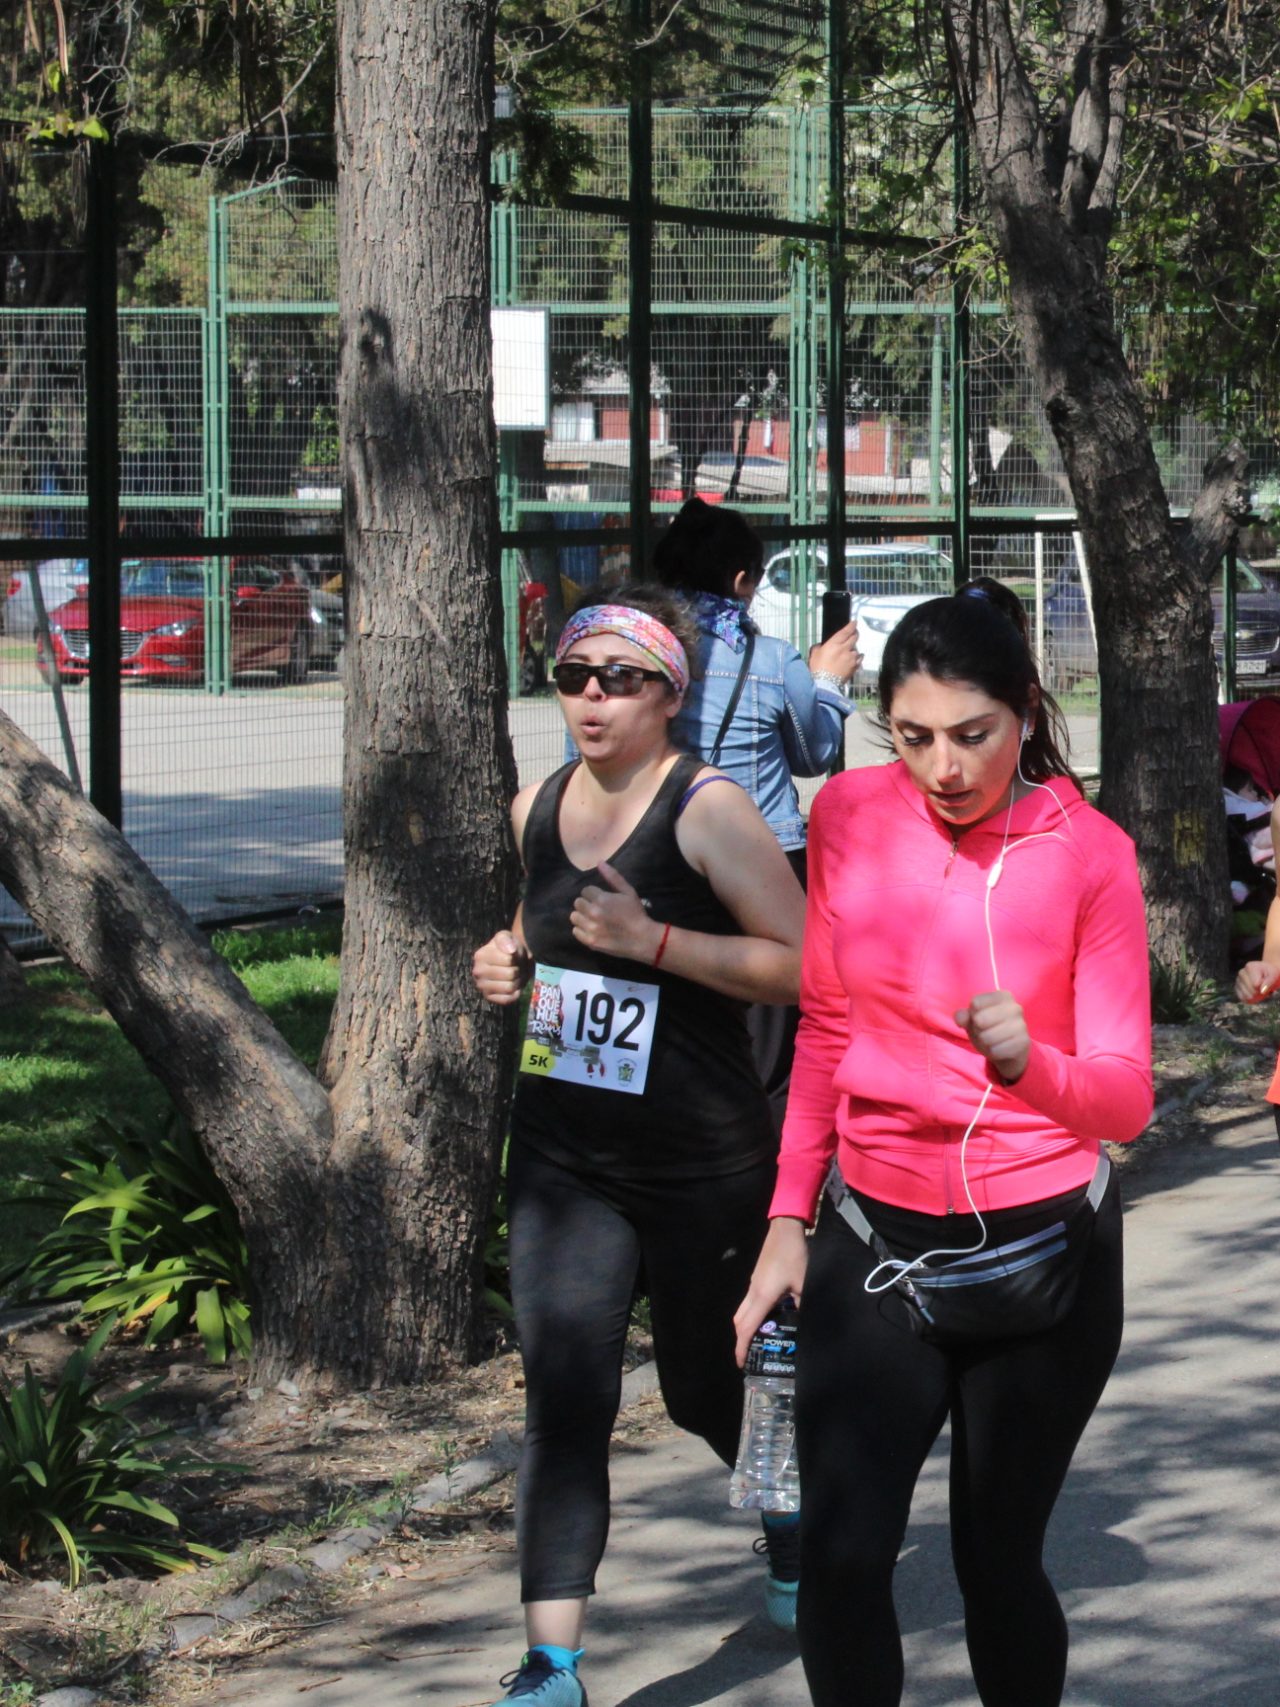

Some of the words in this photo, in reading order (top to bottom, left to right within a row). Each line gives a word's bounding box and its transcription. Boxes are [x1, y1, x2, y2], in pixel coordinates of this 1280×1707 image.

[540, 985, 561, 1000] PAN
[536, 1007, 559, 1023] HUE
[575, 989, 646, 1052] 192
[529, 1054, 548, 1068] 5K
